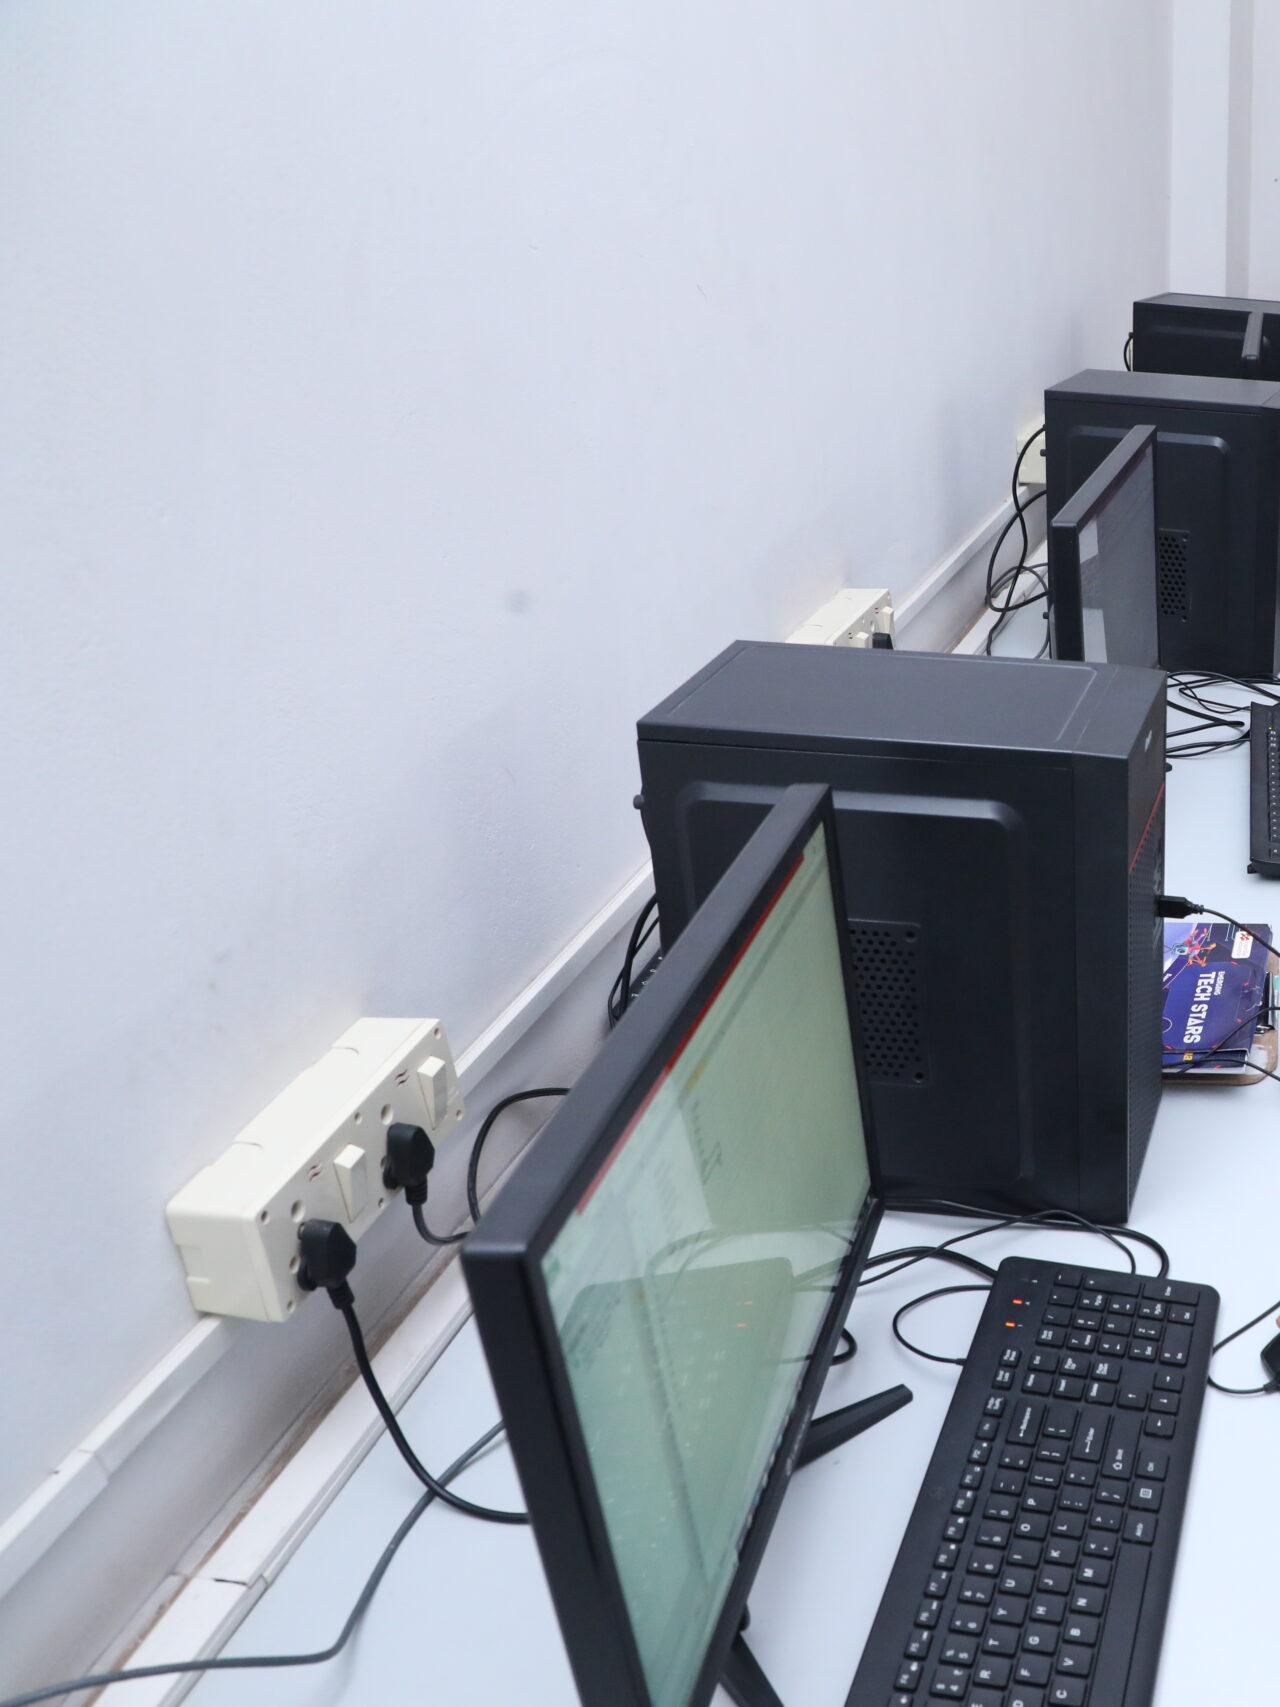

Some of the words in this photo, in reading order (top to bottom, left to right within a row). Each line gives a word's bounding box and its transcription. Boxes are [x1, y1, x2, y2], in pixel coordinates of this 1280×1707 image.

[1193, 971, 1217, 1002] TECH
[1183, 1003, 1209, 1044] STARS
[1026, 1497, 1037, 1506] P
[1019, 1522, 1031, 1532] O
[1050, 1549, 1061, 1558] K
[1082, 1567, 1094, 1578] M
[1004, 1578, 1016, 1588] U
[1043, 1578, 1054, 1586] J
[1076, 1597, 1088, 1607] N
[996, 1607, 1008, 1616] Y
[1035, 1605, 1047, 1615] H
[1069, 1627, 1081, 1637] B
[987, 1637, 1000, 1646] T
[1028, 1635, 1040, 1646] G
[1062, 1656, 1074, 1667] V
[979, 1669, 992, 1680] R
[1019, 1667, 1031, 1677] F
[1055, 1689, 1068, 1700] C
